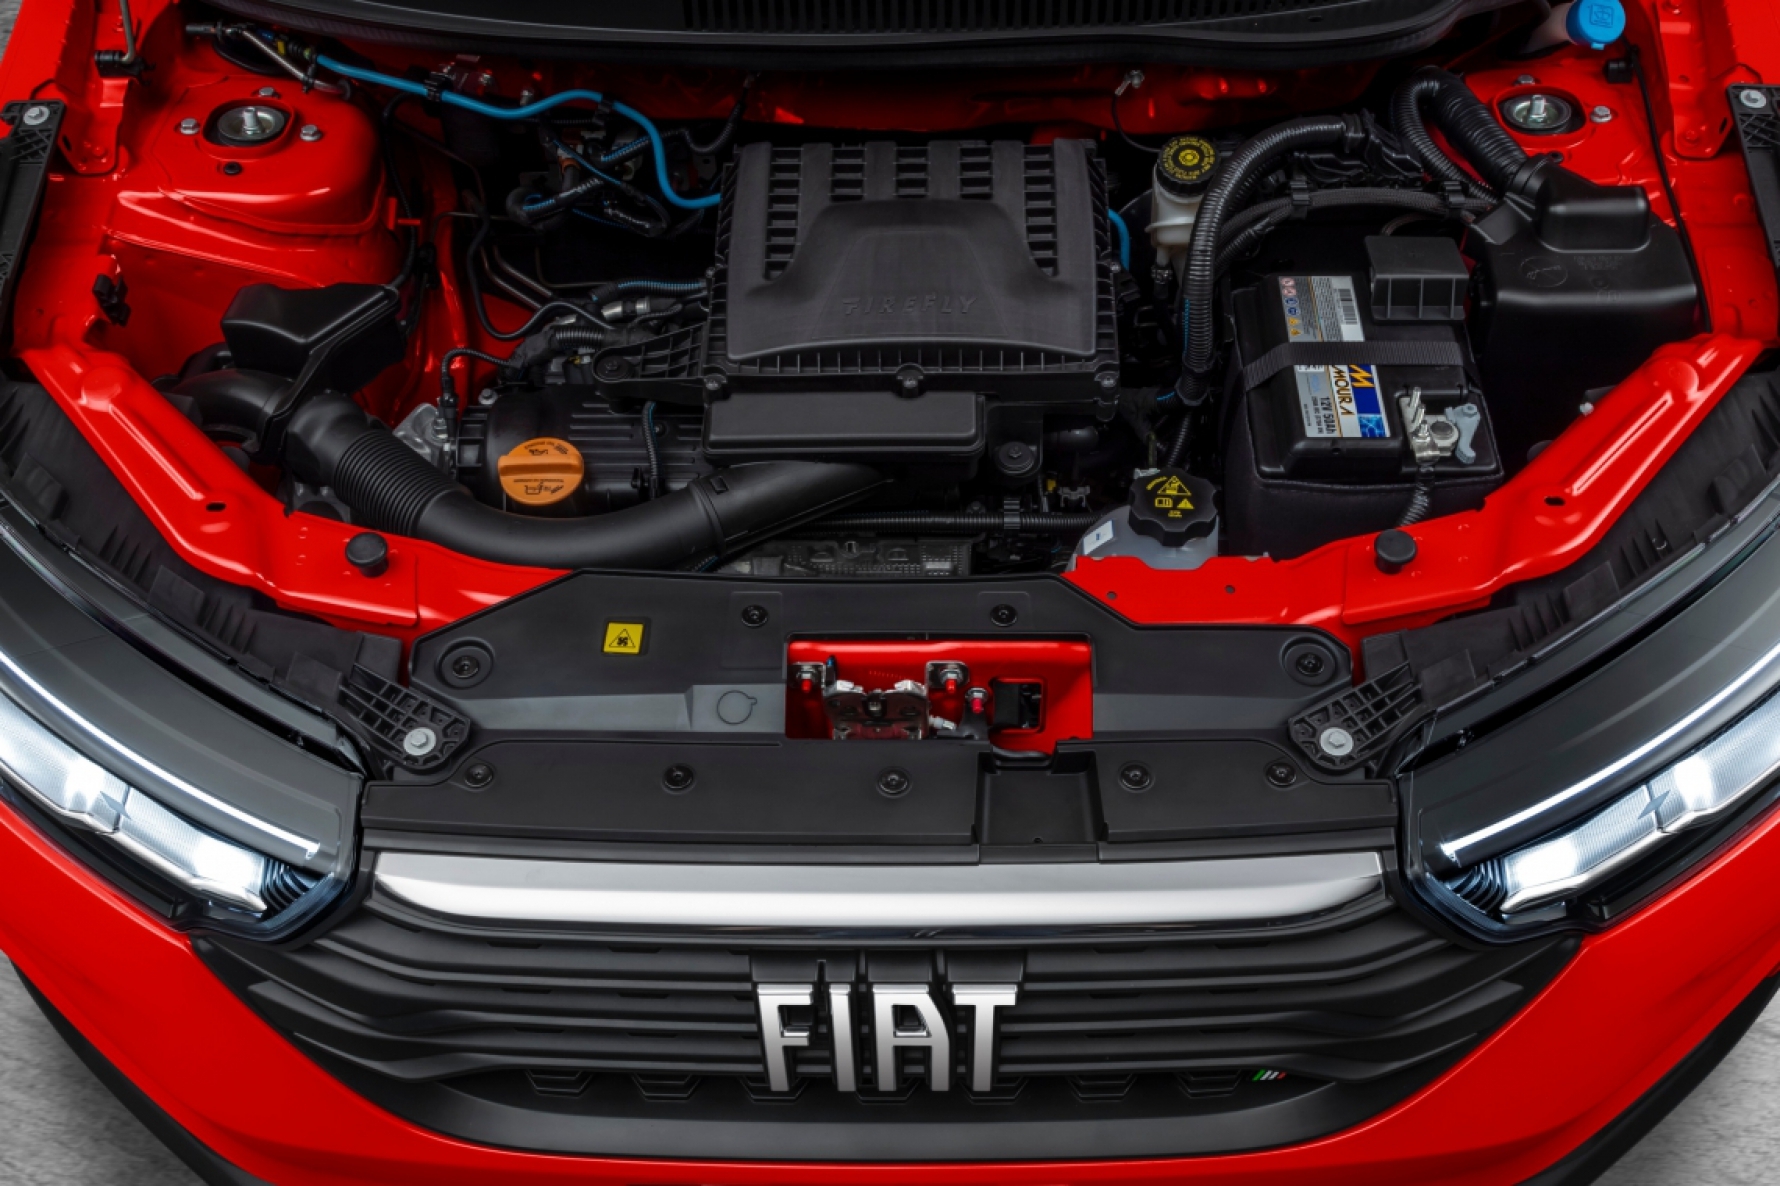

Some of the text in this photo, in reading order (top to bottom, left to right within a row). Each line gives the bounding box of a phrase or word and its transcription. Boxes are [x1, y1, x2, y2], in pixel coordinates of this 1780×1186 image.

[842, 292, 977, 315] FIREFLY
[1333, 365, 1355, 415] MOURA
[757, 983, 1018, 1092] FIAT
